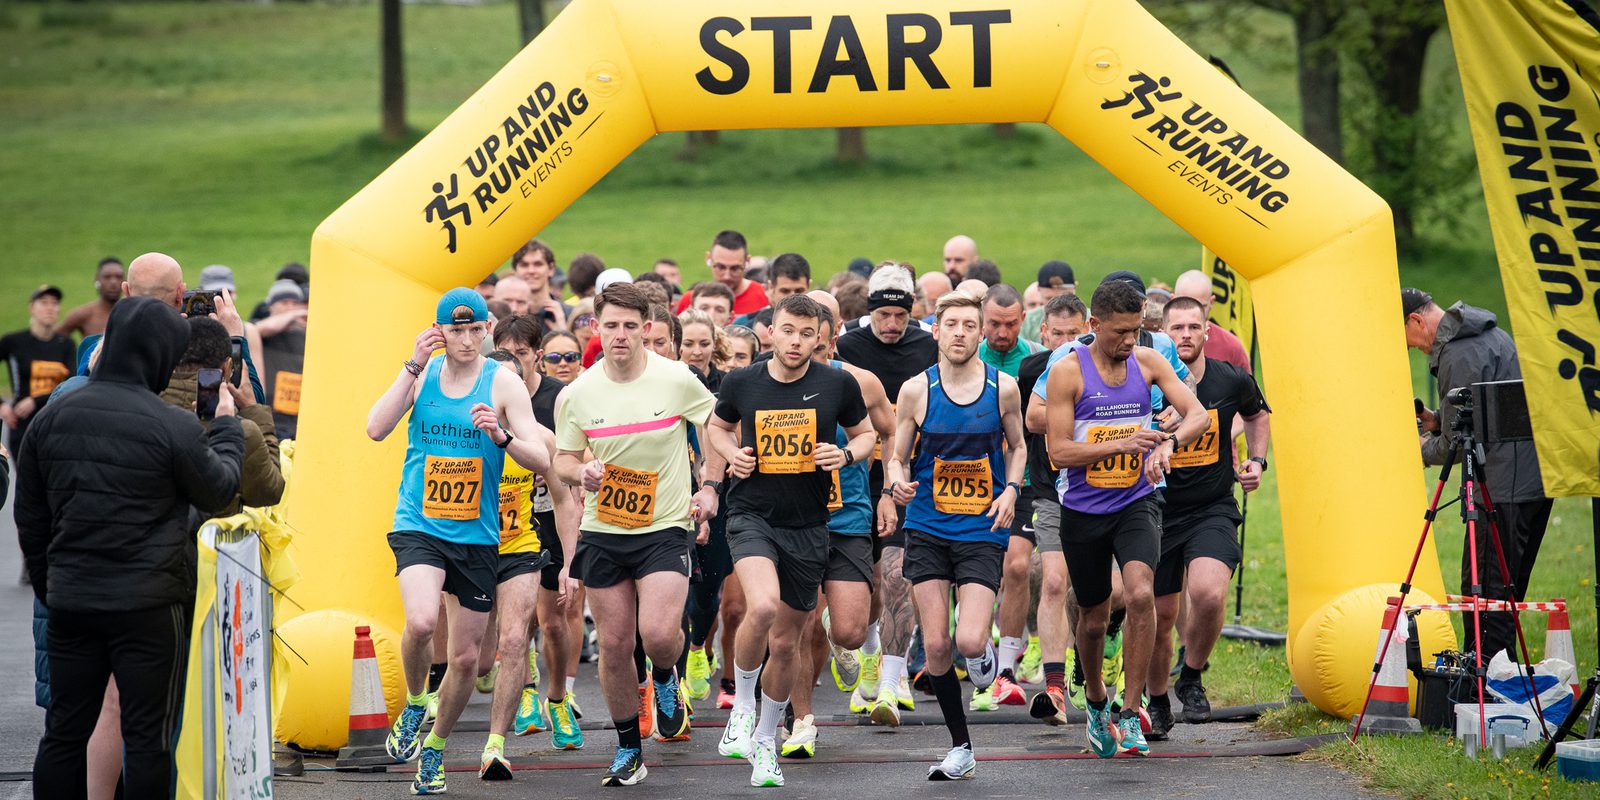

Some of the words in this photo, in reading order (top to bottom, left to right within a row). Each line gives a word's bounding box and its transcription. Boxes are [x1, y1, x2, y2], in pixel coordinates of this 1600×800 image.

[695, 9, 1012, 95] START
[462, 133, 501, 178] UP
[499, 81, 557, 143] AND
[1181, 98, 1228, 135] UP
[1218, 129, 1290, 180] AND
[469, 87, 589, 213] RUNNING
[519, 141, 573, 199] EVENTS
[1146, 113, 1289, 213] RUNNING
[1495, 101, 1563, 229] AND
[1167, 159, 1233, 205] EVENTS
[1530, 232, 1584, 319] UP
[777, 413, 788, 421] UP
[1095, 403, 1141, 411] BELLAHOUSTON
[421, 420, 481, 439] Lothian
[773, 418, 810, 428] RUNNING
[1118, 427, 1135, 435] AND
[421, 436, 458, 449] Running
[460, 440, 480, 449] Club
[760, 433, 813, 457] 2056
[440, 466, 477, 474] RUNNING
[617, 476, 652, 486] RUNNING
[632, 472, 649, 480] AND
[427, 479, 480, 503] 2027
[937, 476, 989, 499] 2055
[600, 484, 652, 516] 2082
